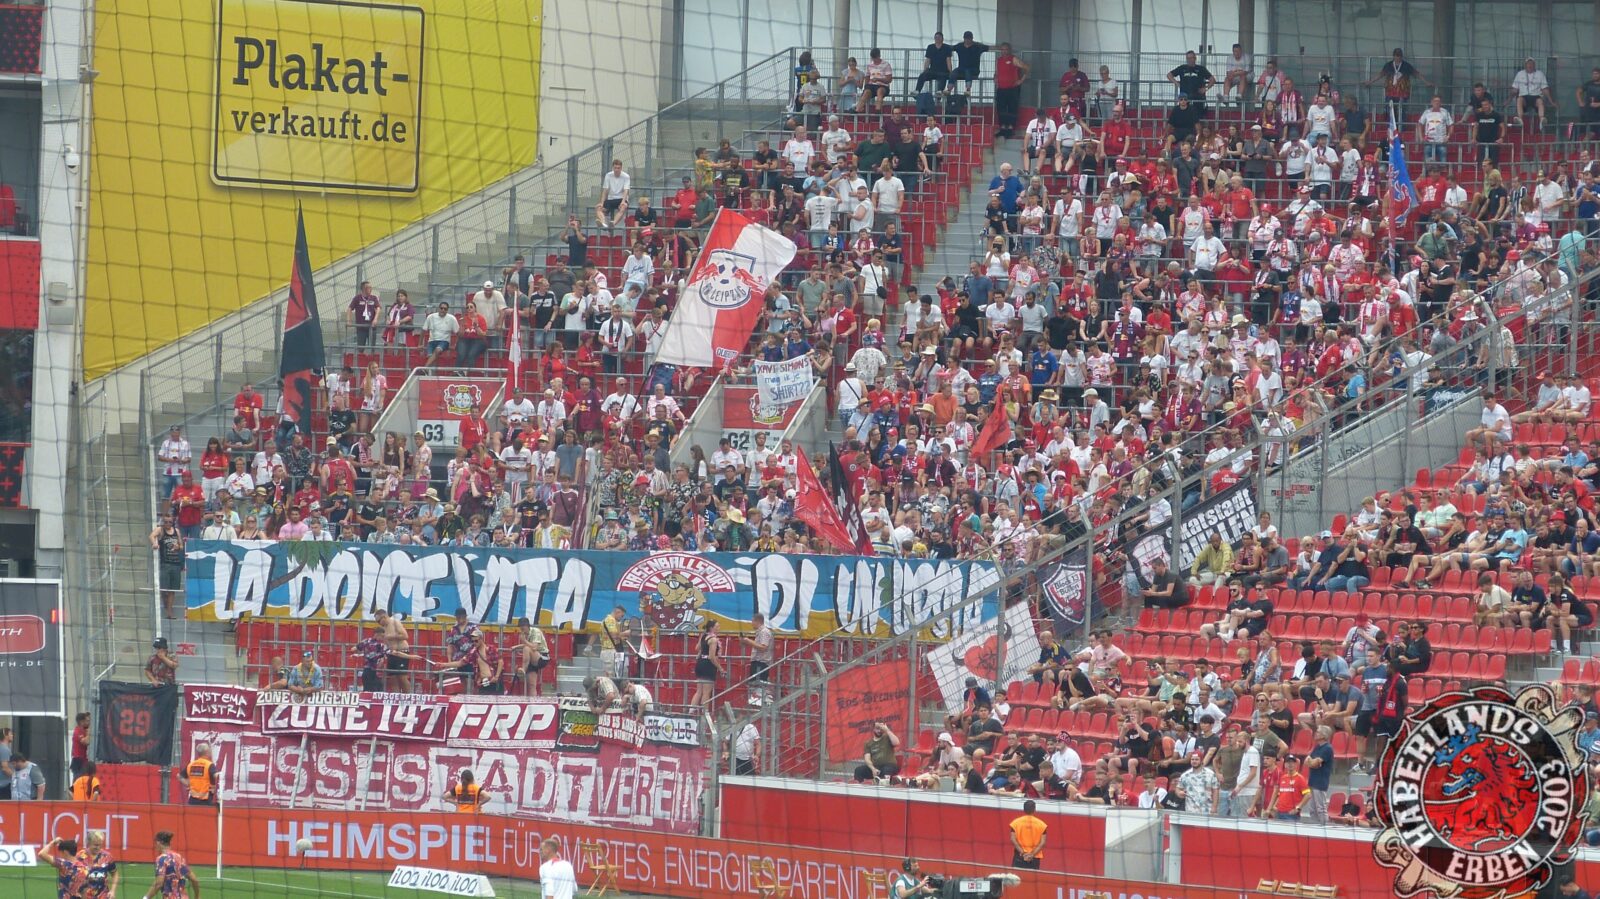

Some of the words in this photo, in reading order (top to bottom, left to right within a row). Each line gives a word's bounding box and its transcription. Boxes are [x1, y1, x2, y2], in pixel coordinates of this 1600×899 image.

[233, 36, 409, 97] Plakat-
[231, 107, 408, 145] verkauft.de
[756, 364, 778, 375] XAVI
[779, 357, 809, 372] SIMONS
[422, 423, 444, 442] G3
[727, 431, 750, 451] G2
[621, 556, 732, 589] RASENBALLSPORT
[213, 550, 275, 621] LA
[286, 549, 452, 623] DOLCE
[452, 551, 596, 632] VITA
[751, 553, 819, 631] DI
[256, 692, 290, 704] ZONE
[307, 692, 360, 708] JUGEND
[119, 708, 152, 737] 29
[267, 703, 370, 731] ZONE
[376, 701, 445, 735] 147
[448, 703, 556, 740] FRP
[19, 812, 139, 850] LICHT
[267, 819, 498, 864] HEIMSPIEL
[503, 822, 541, 868] FÜR
